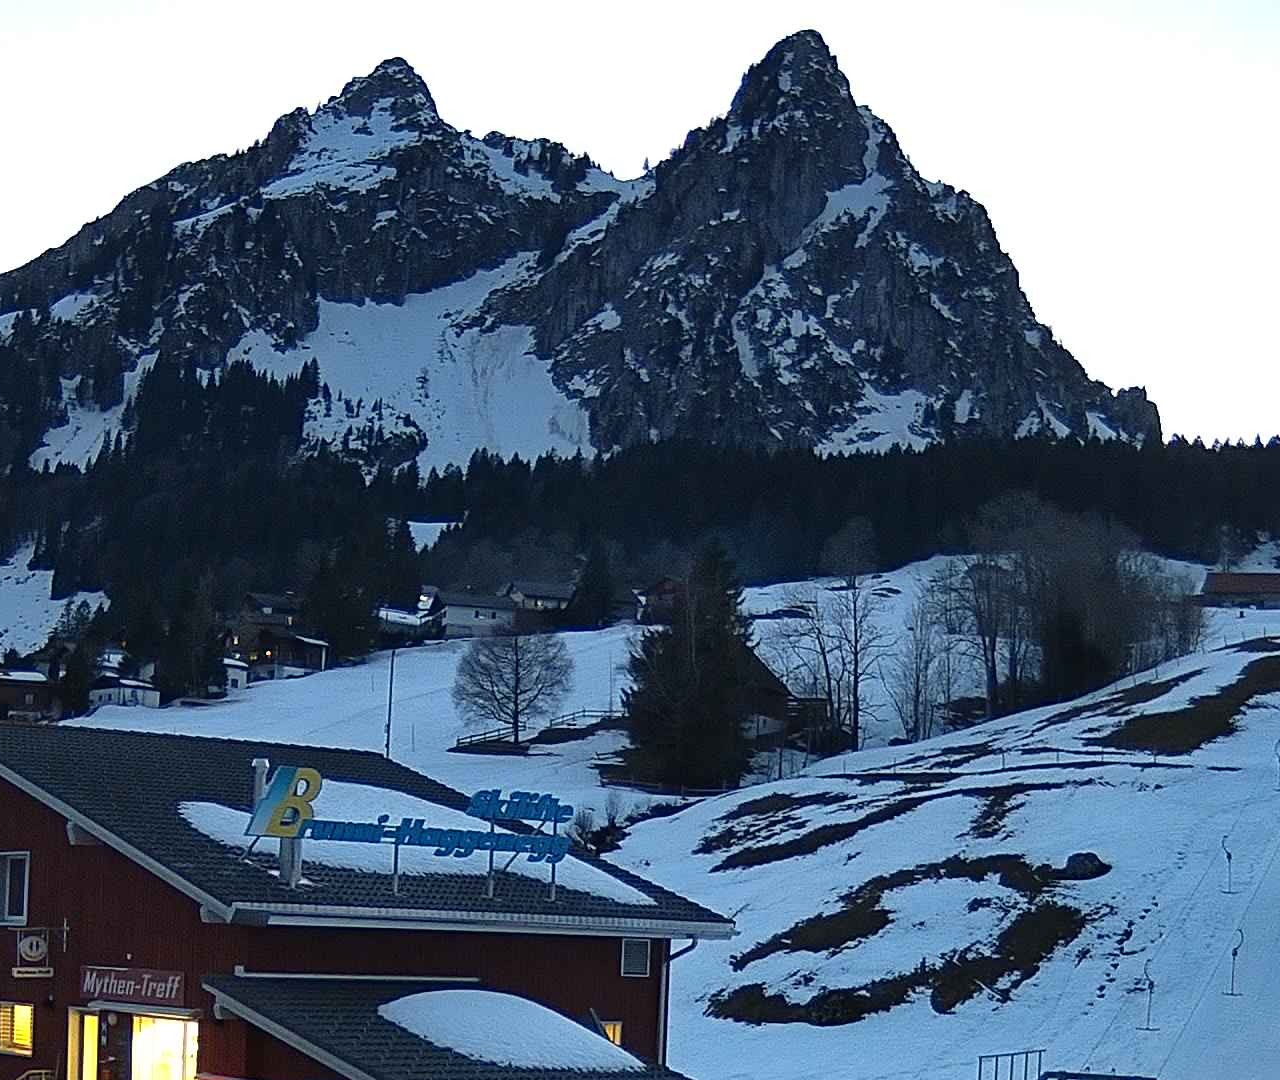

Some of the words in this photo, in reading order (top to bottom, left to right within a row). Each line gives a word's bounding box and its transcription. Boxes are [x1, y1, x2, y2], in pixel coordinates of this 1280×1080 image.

[247, 767, 570, 864] Brunni-Haggenegg
[468, 789, 574, 823] Skilifte
[83, 971, 181, 999] Mythen-Treff
